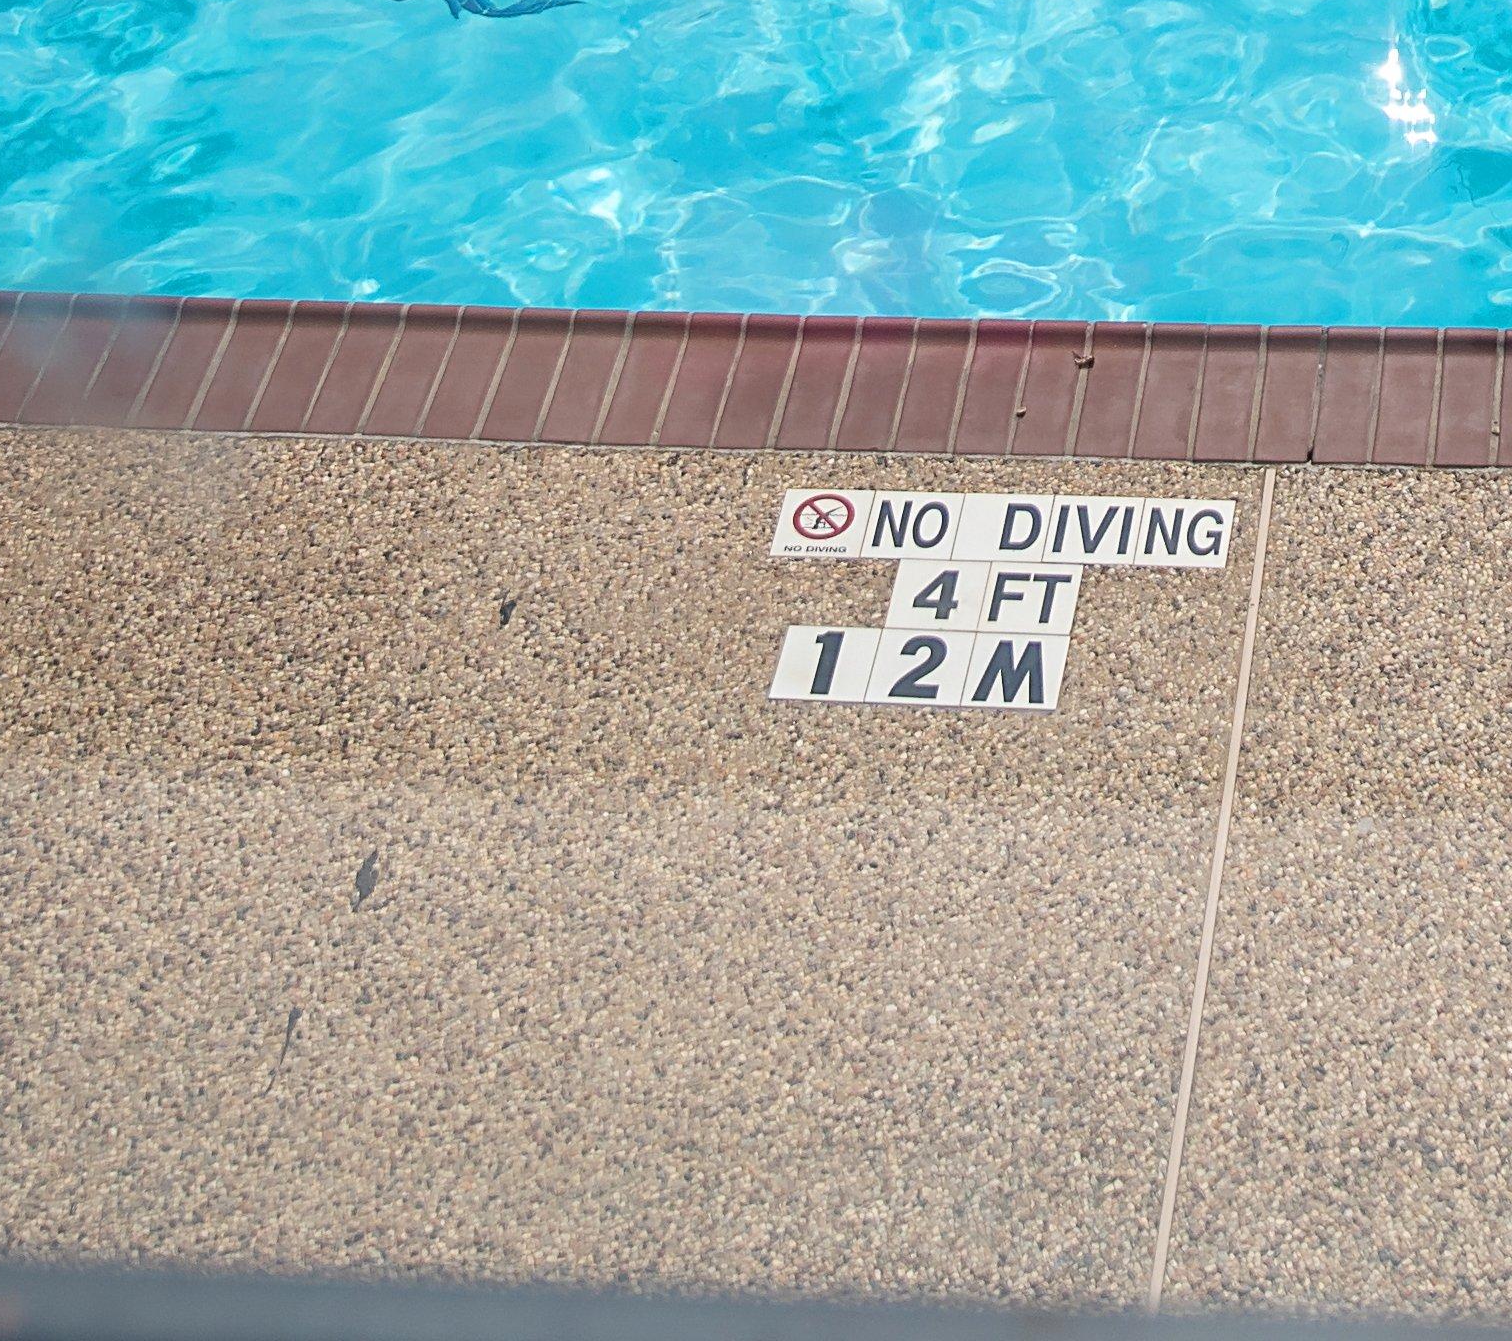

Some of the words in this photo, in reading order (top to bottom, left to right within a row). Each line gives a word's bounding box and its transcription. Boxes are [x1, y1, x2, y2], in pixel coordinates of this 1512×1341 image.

[783, 545, 802, 553] NO
[805, 545, 847, 553] DIVING
[871, 499, 949, 549] NO
[998, 502, 1224, 557] DIVING
[913, 569, 959, 620] 4
[988, 572, 1073, 624] FT
[809, 630, 845, 695] 1
[888, 634, 947, 699] 2
[971, 640, 1045, 704] M
